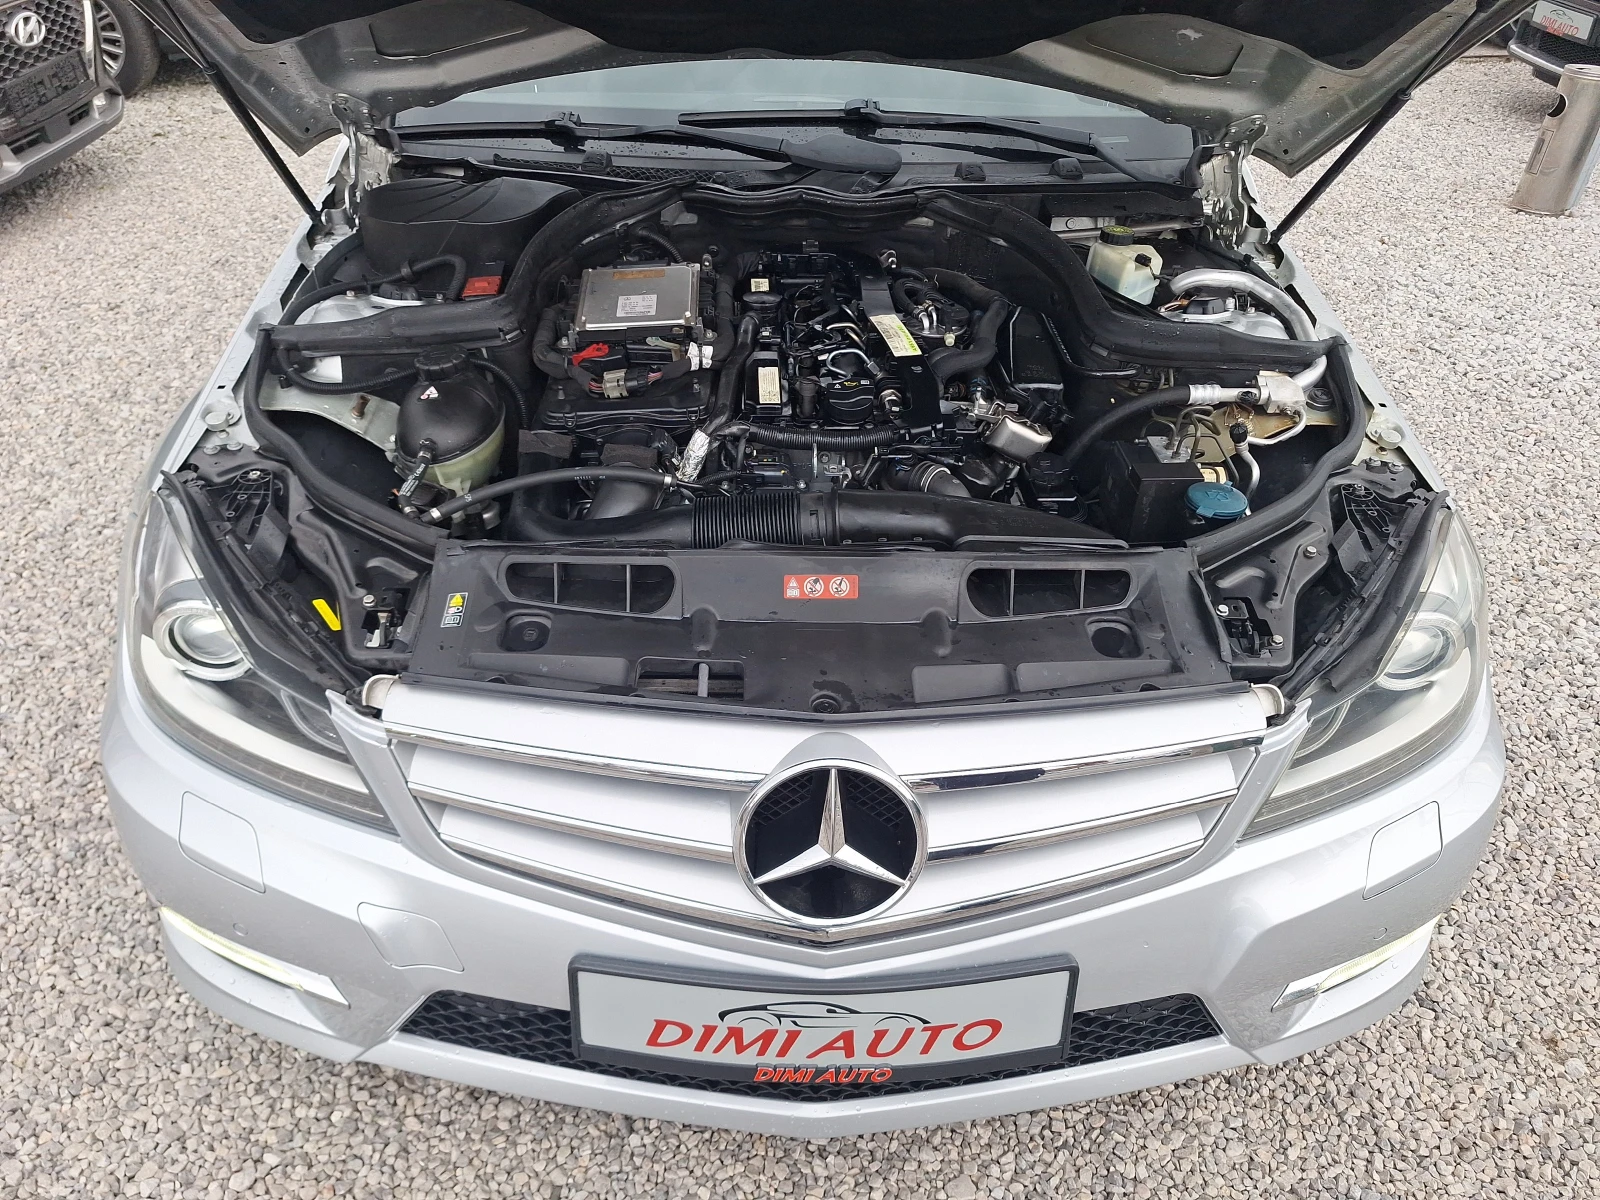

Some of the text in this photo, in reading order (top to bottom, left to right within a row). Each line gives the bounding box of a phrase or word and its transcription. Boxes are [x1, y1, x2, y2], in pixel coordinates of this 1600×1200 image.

[1540, 15, 1557, 29] DIMI
[1557, 22, 1580, 36] AUTO
[646, 1018, 1003, 1059] DIMI AUTO
[754, 1066, 893, 1083] DIMI AUTO
